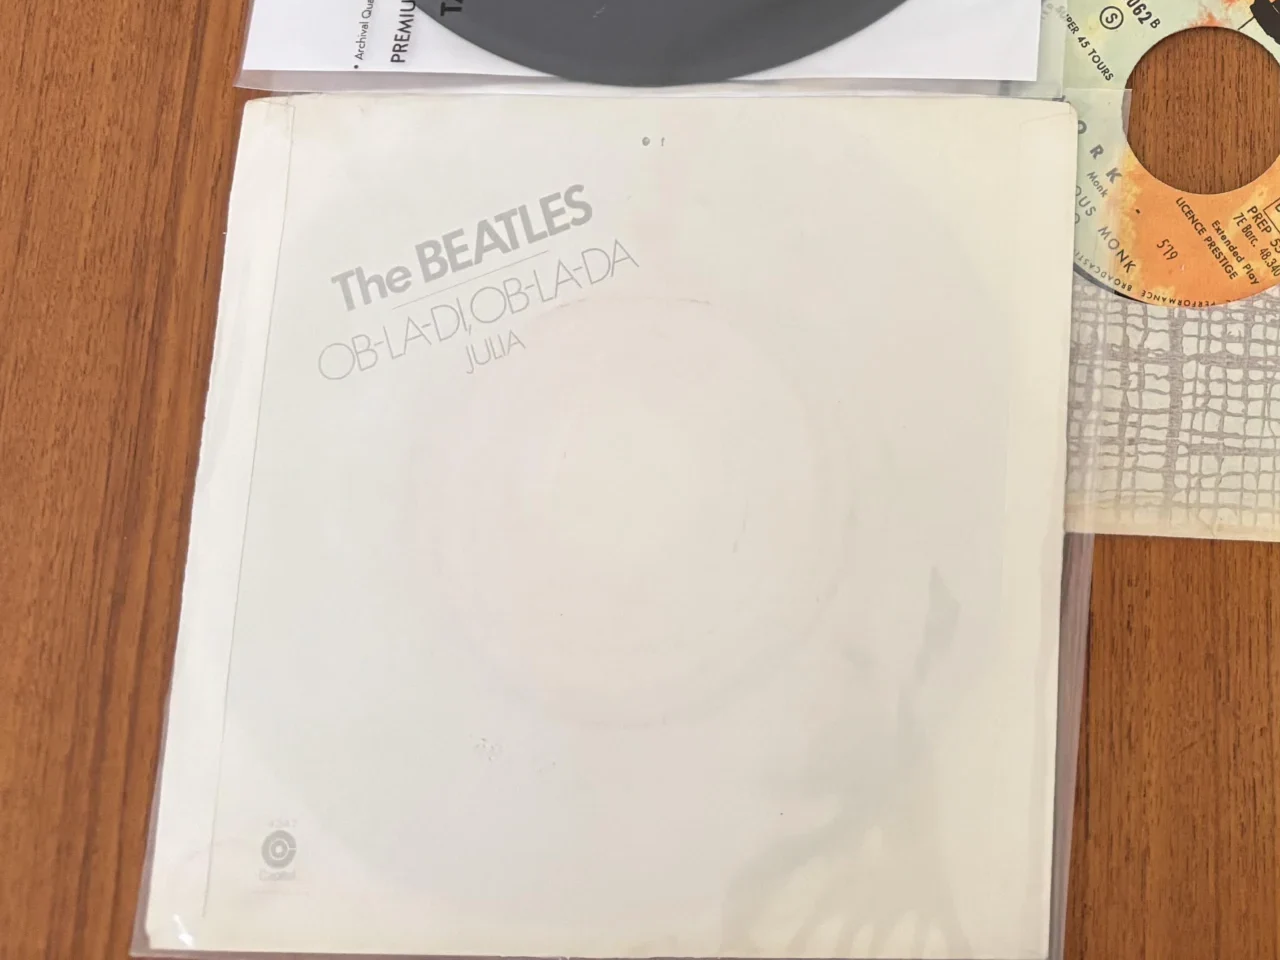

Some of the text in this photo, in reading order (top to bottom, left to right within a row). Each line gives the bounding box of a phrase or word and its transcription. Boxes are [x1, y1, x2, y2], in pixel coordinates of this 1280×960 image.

[355, 22, 368, 60] Archival
[1078, 36, 1114, 81] 45 TOURS
[1087, 171, 1108, 198] Monk
[1176, 197, 1207, 242] LICENCE
[1203, 237, 1239, 279] PRESTIGE
[1245, 205, 1272, 234] PREP
[332, 184, 593, 312] The BEATLES
[1098, 226, 1136, 273] MONK
[1211, 220, 1259, 285] Extended Play
[466, 330, 526, 375] JULIA
